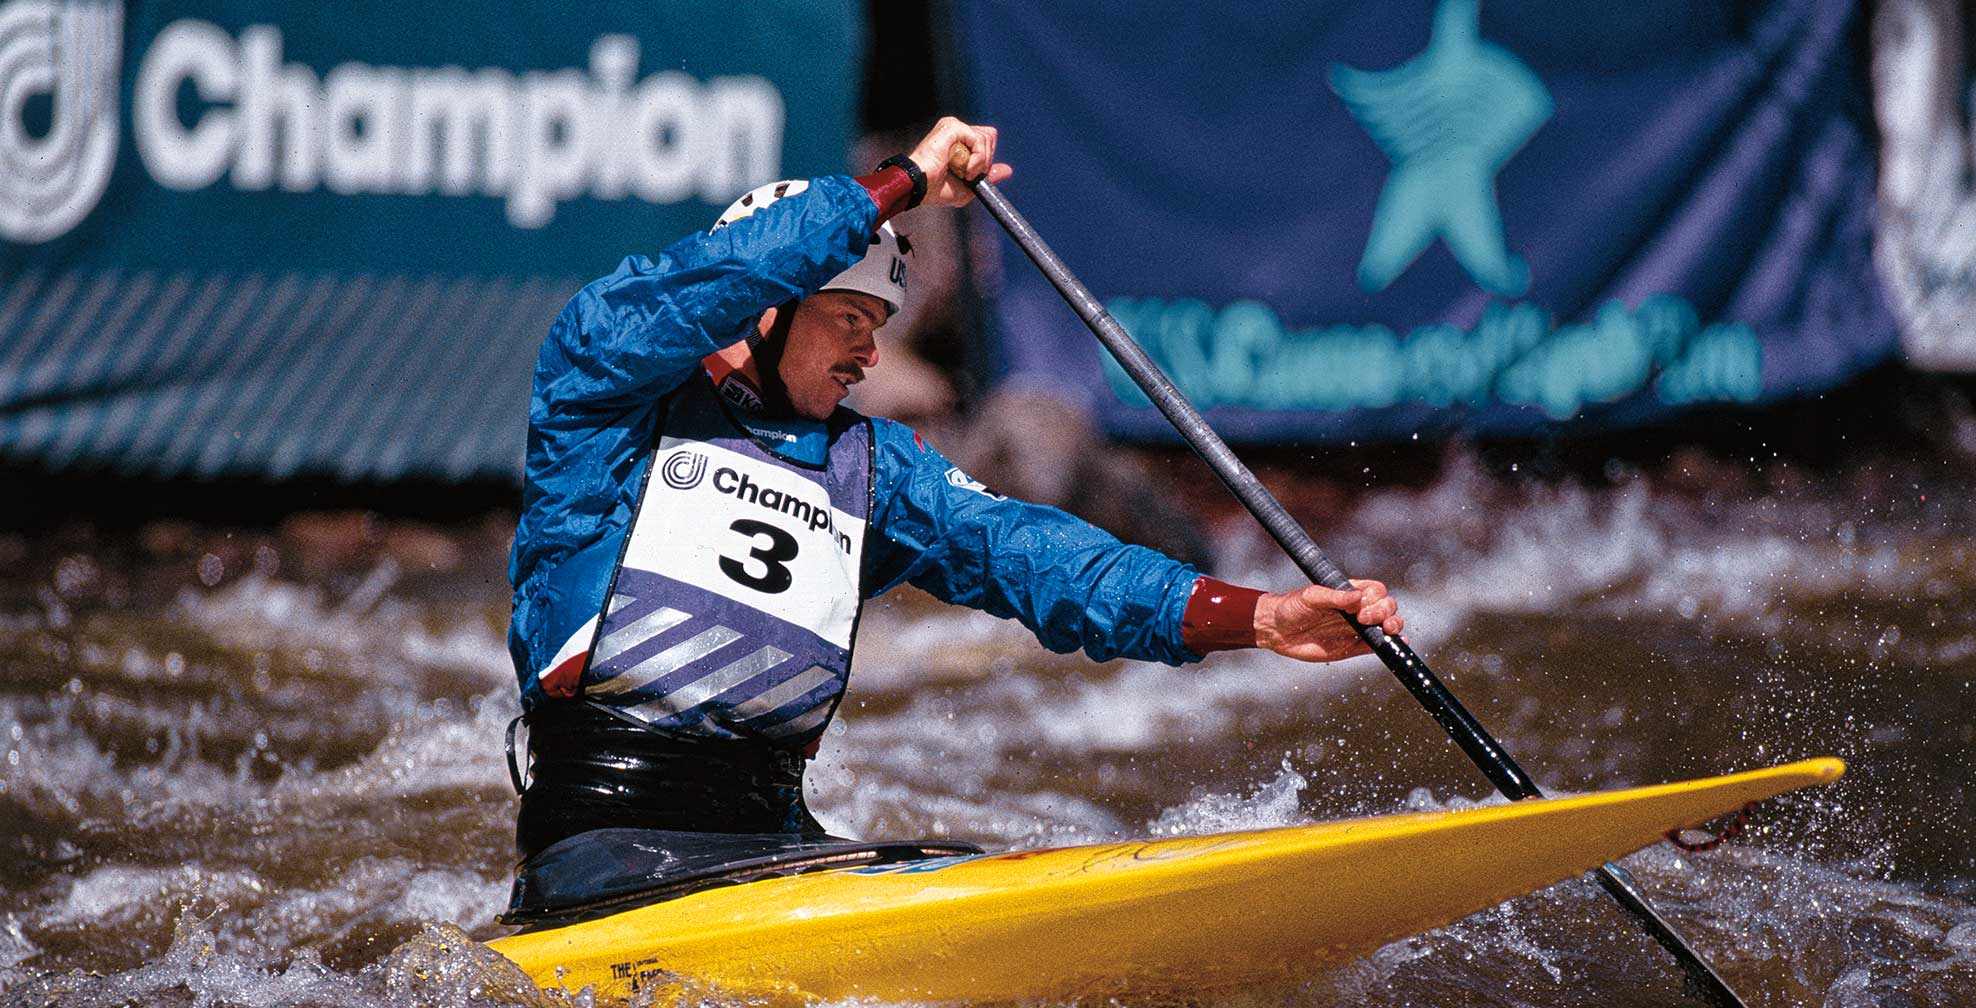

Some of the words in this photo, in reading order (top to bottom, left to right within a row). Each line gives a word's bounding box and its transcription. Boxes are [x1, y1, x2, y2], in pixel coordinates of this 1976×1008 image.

[135, 20, 783, 227] Champion
[741, 424, 798, 443] hampion
[718, 518, 799, 594] 3
[610, 962, 632, 980] THE
